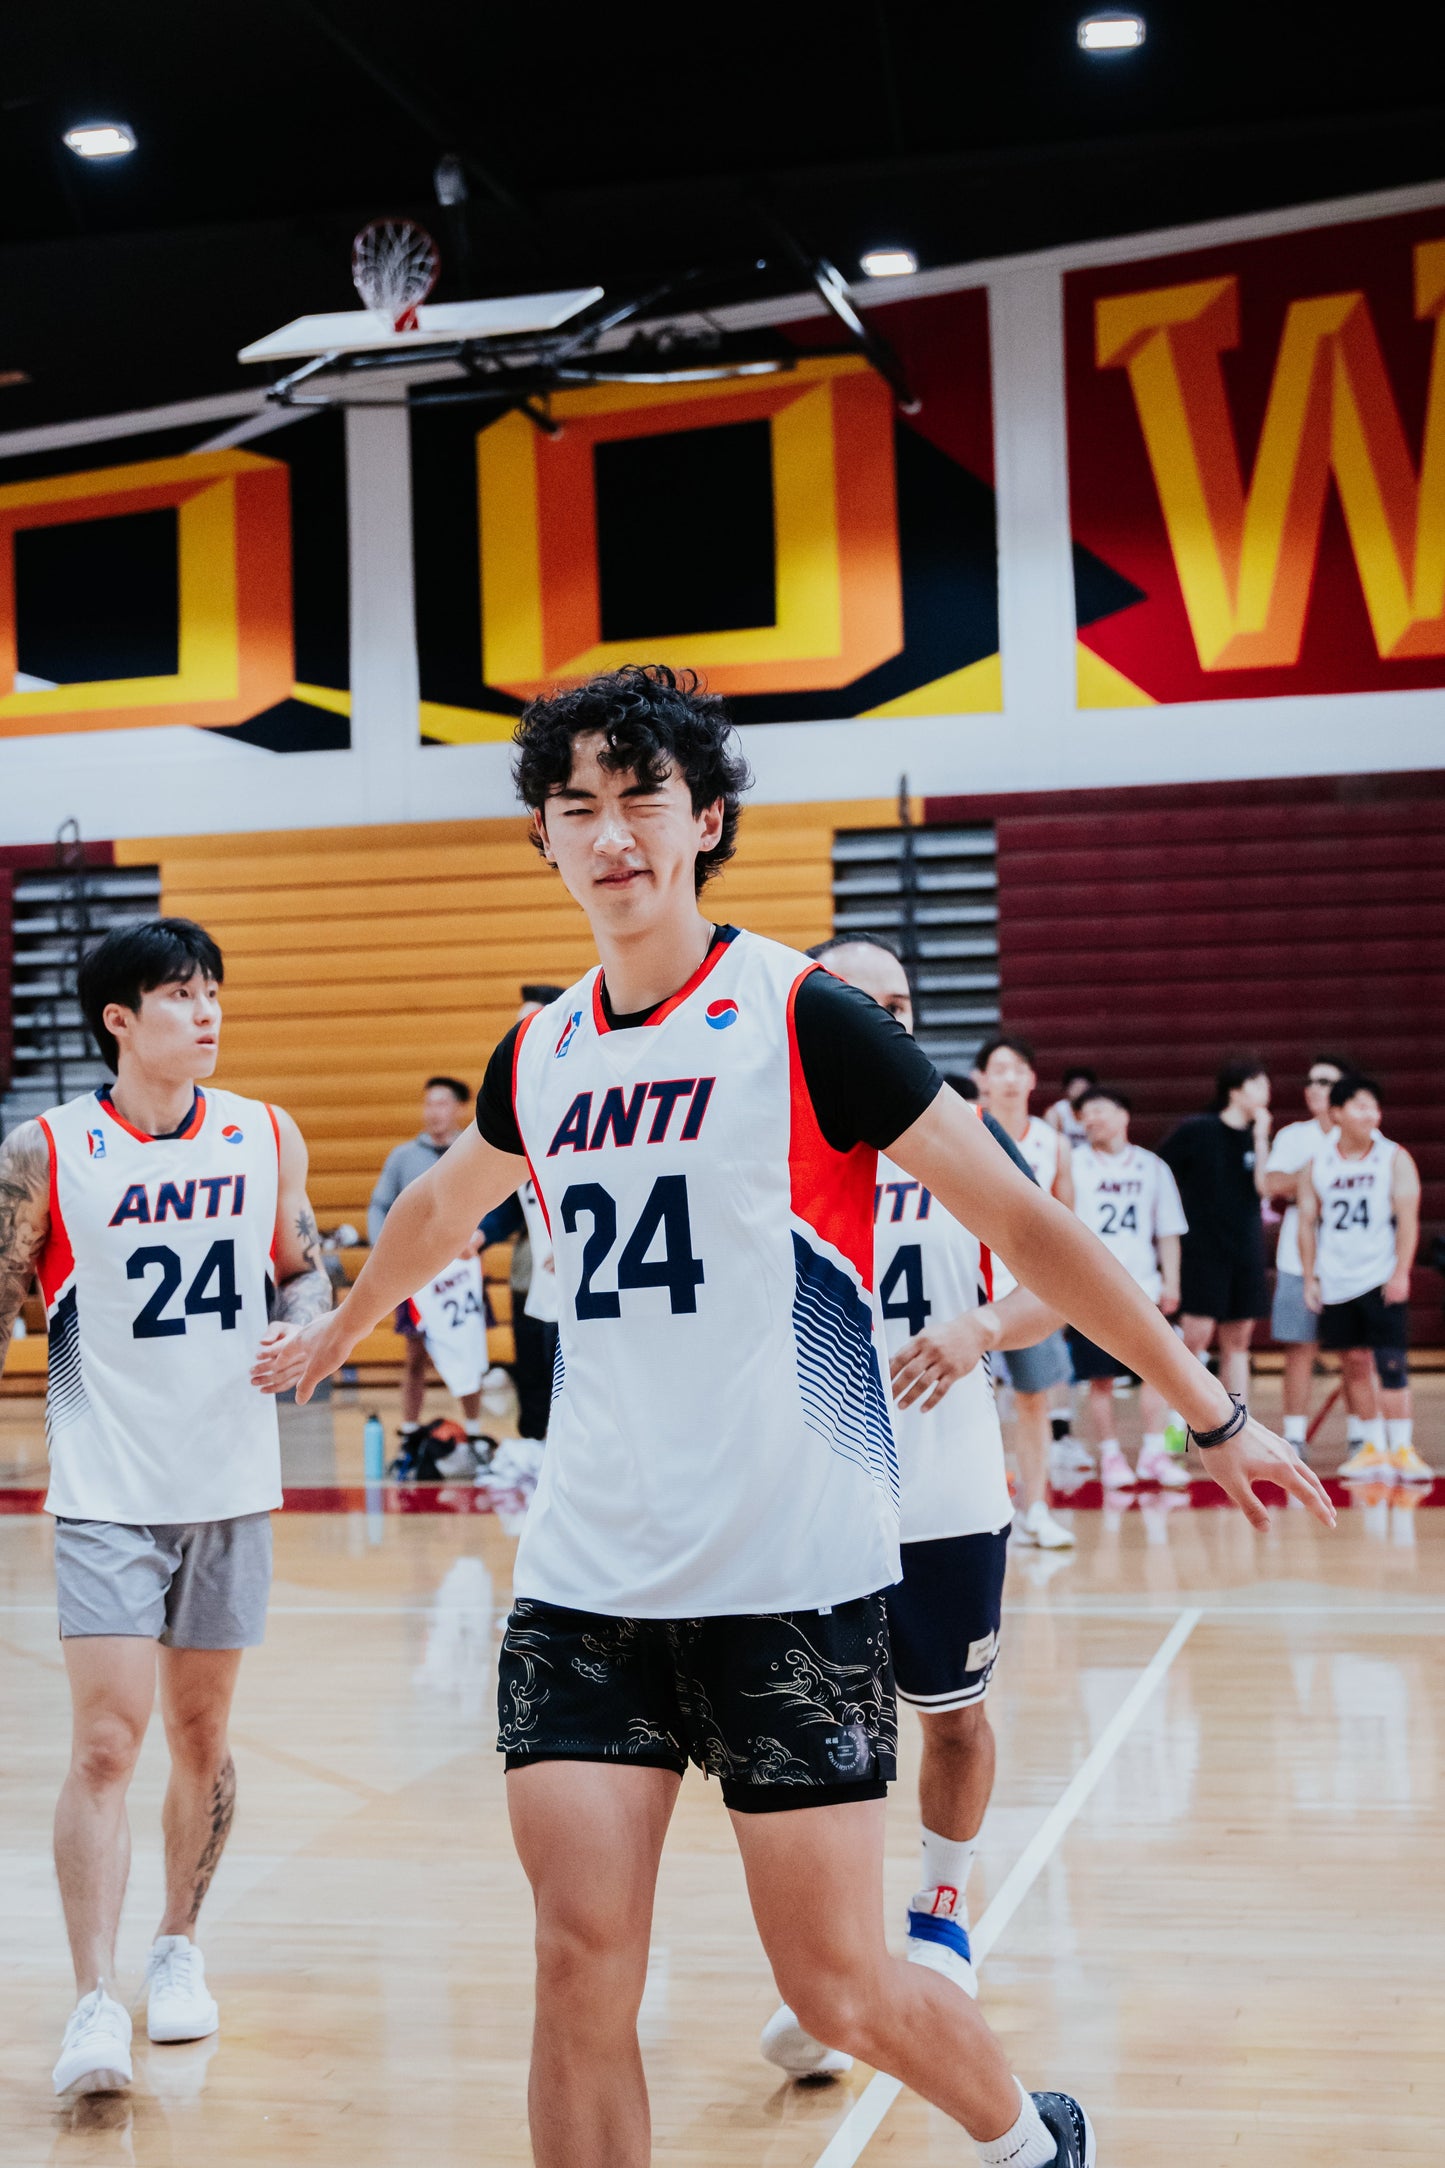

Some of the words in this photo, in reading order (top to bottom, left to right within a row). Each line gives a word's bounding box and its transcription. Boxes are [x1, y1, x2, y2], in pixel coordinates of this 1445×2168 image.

[546, 1077, 716, 1157] ANTI
[108, 1174, 246, 1227] ANTI
[874, 1182, 932, 1224] TI
[1098, 1180, 1142, 1193] ANTI
[1099, 1203, 1137, 1234] 24
[1332, 1198, 1370, 1230] 24
[560, 1174, 705, 1321] 24
[126, 1239, 242, 1339] 24
[443, 1290, 481, 1328] 24
